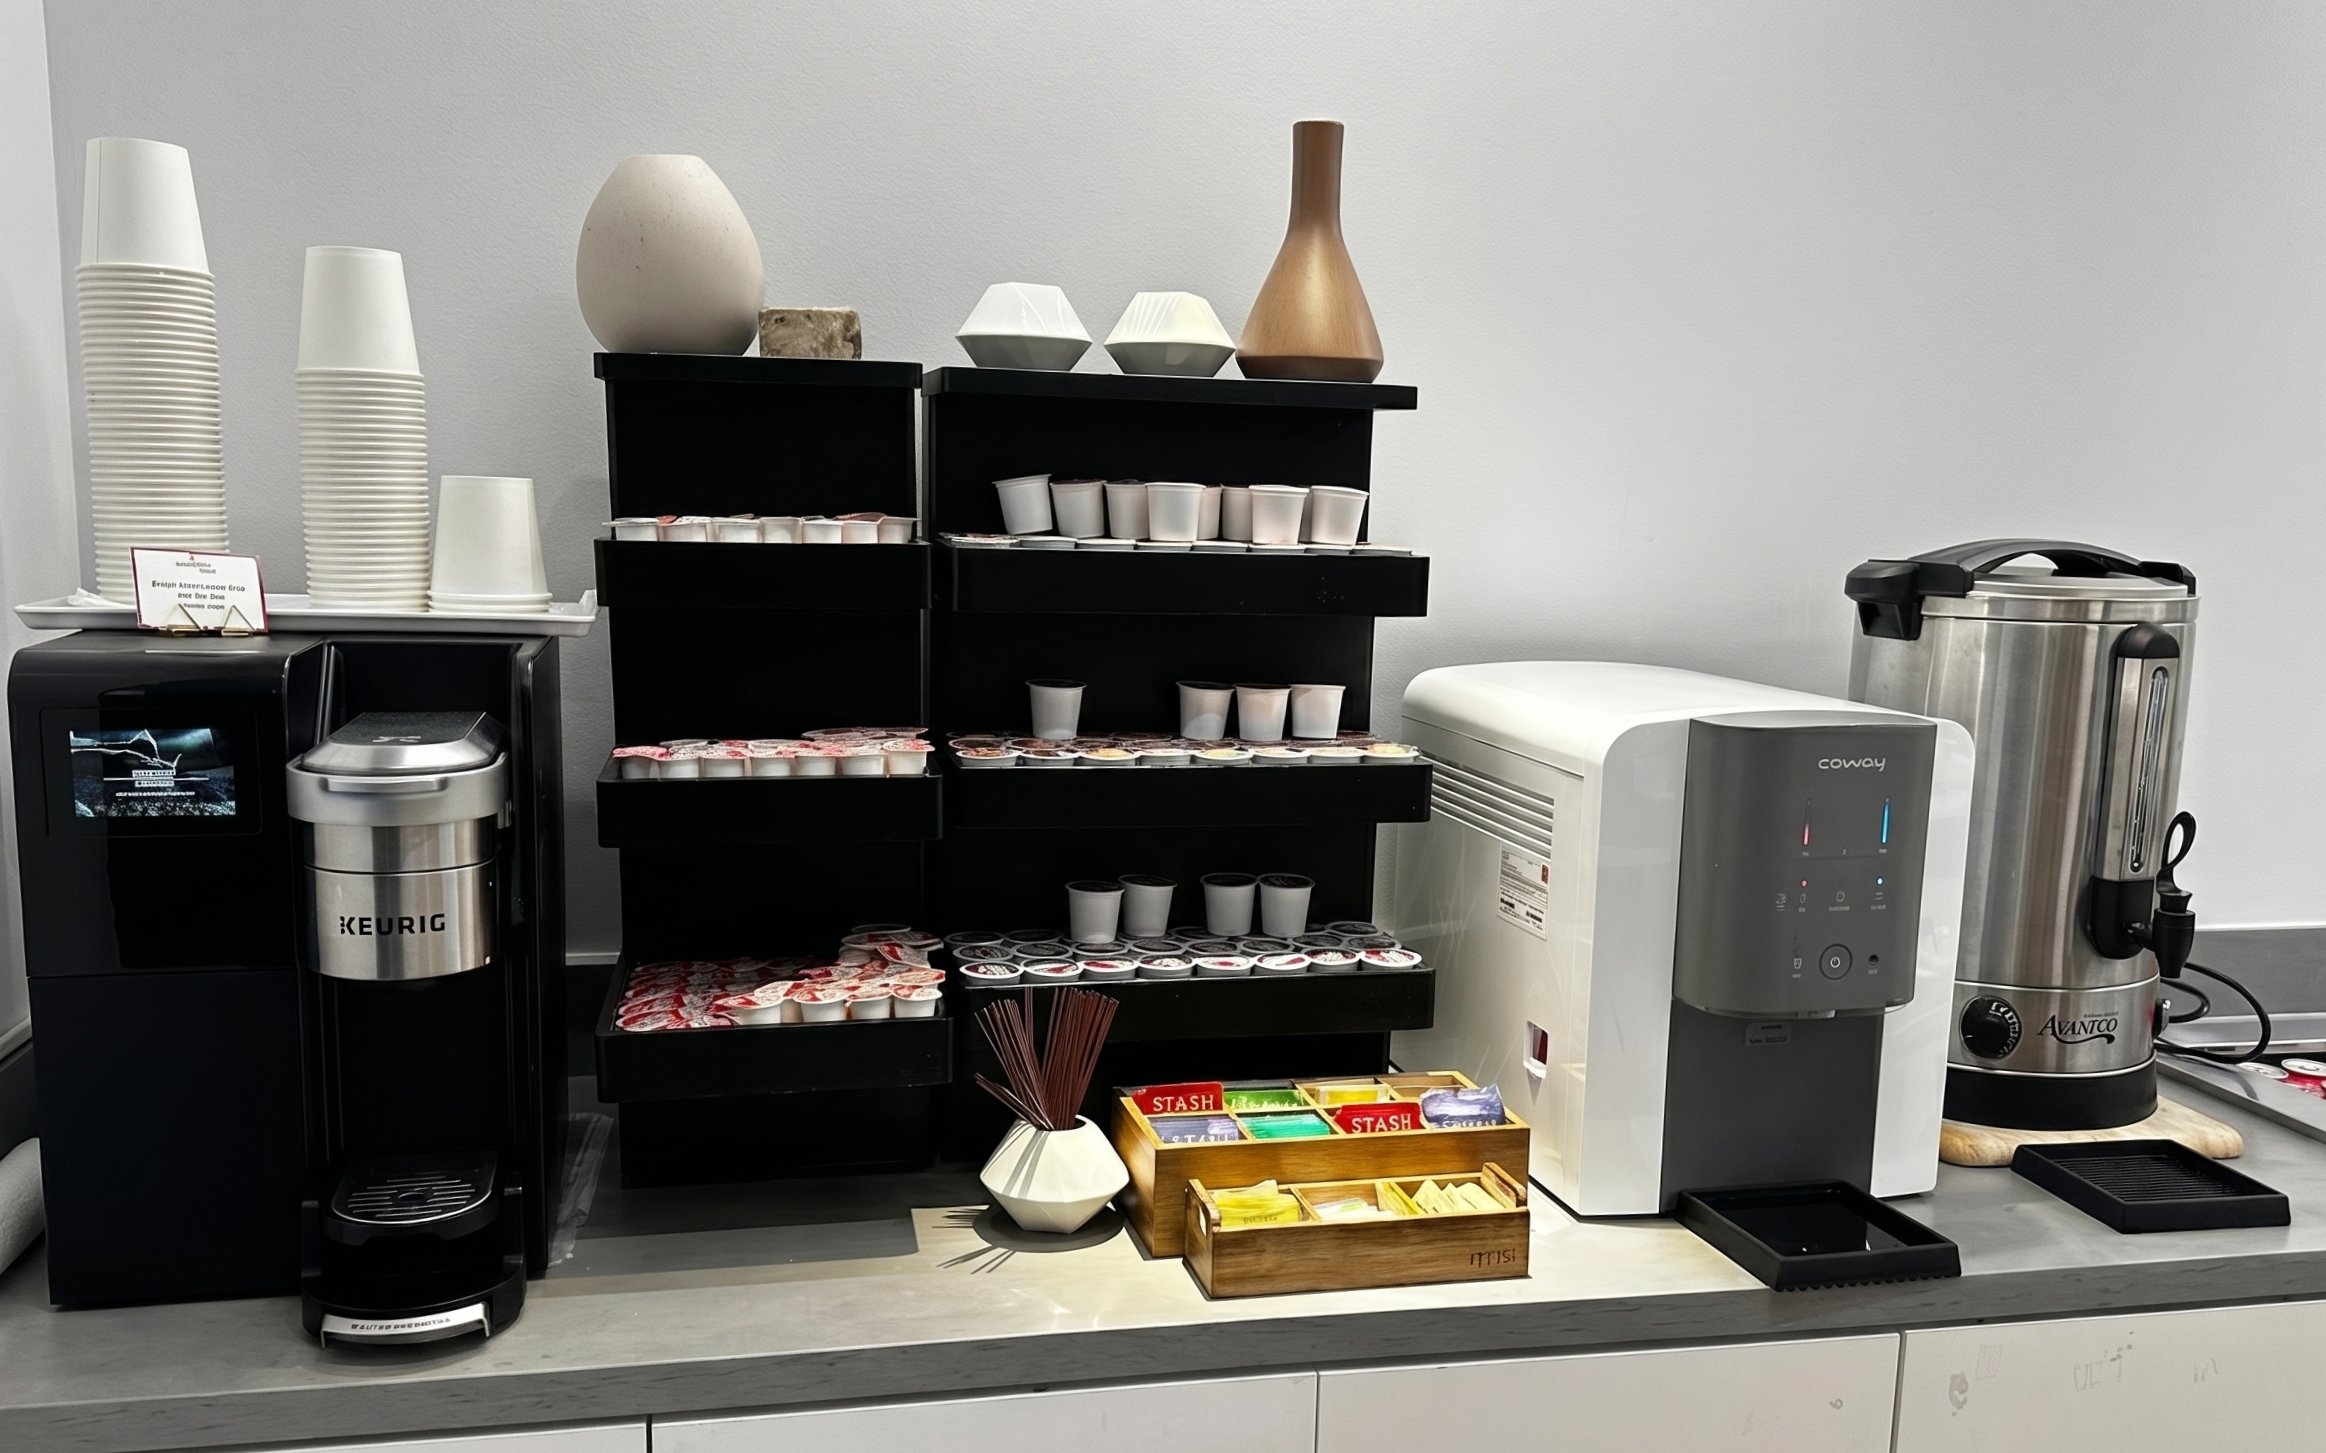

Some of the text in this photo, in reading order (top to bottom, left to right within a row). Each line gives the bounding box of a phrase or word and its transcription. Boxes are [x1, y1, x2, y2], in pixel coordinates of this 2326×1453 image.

[1818, 757, 1886, 772] coway
[340, 913, 445, 936] KEURIG
[2037, 1014, 2118, 1044] AVANTCO
[1152, 1095, 1214, 1112] STASH
[1351, 1113, 1412, 1134] STASH
